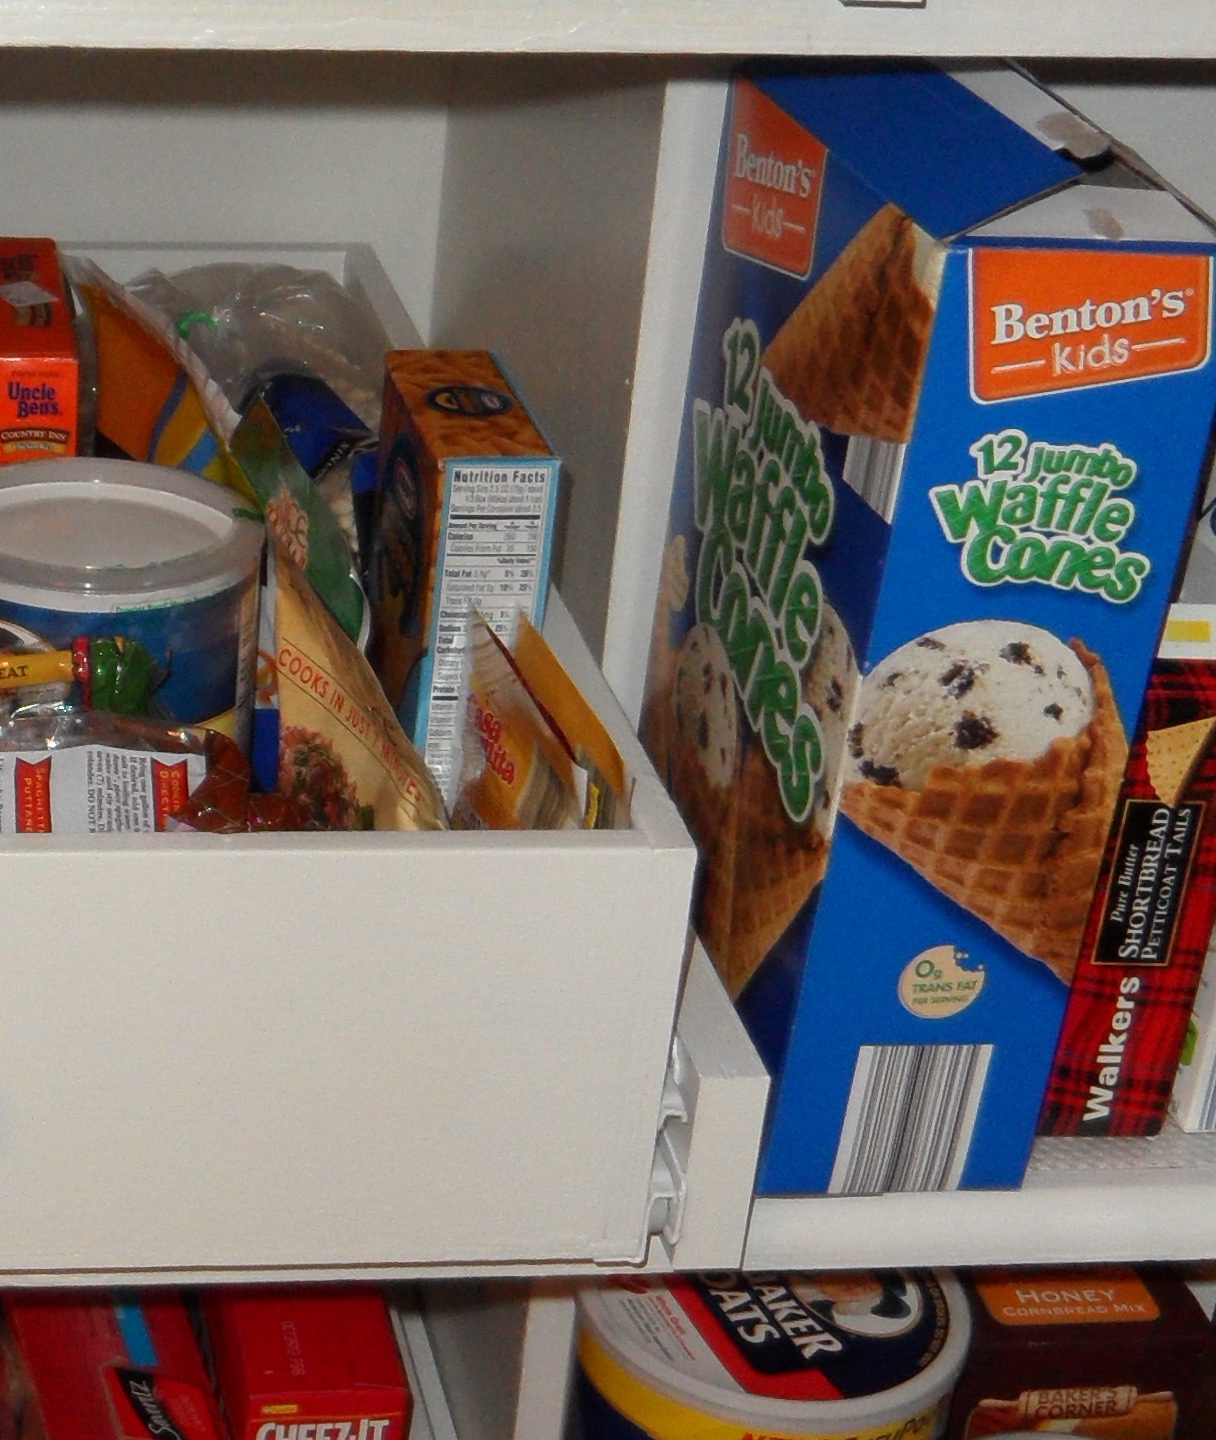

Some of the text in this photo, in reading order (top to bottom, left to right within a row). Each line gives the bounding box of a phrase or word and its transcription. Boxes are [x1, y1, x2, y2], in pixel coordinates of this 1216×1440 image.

[735, 133, 813, 198] Benton's
[751, 199, 785, 239] kids
[990, 288, 1186, 346] Benton's
[725, 320, 759, 417] 12
[1052, 335, 1130, 376] kids
[7, 381, 56, 400] Uncle
[0, 429, 68, 441] COUNTRY INN
[750, 366, 834, 545] jumbo
[974, 435, 1136, 487] 12 jumbo
[454, 470, 546, 484] Nutrition Facts
[695, 400, 822, 666] Waffle
[931, 478, 1134, 544] Waffle
[967, 530, 1150, 602] Cones
[278, 647, 329, 695] COOKS
[329, 688, 344, 710] IN
[344, 707, 372, 743] JUST
[698, 531, 823, 820] Cones
[1110, 844, 1140, 923] Pure Butter
[1119, 807, 1171, 959] SHORTBREAD
[1140, 807, 1192, 960] PETTICOAT TAILS
[912, 980, 978, 993] TRANS FAT
[915, 959, 942, 979] 0g
[1083, 975, 1141, 1122] Walkers
[742, 1272, 843, 1360] AKER
[1003, 1303, 1146, 1318] CORNBREAD MIX
[1015, 1288, 1116, 1304] HONEY
[1035, 1400, 1118, 1420] CORNER
[1038, 1388, 1119, 1405] BAKER'S
